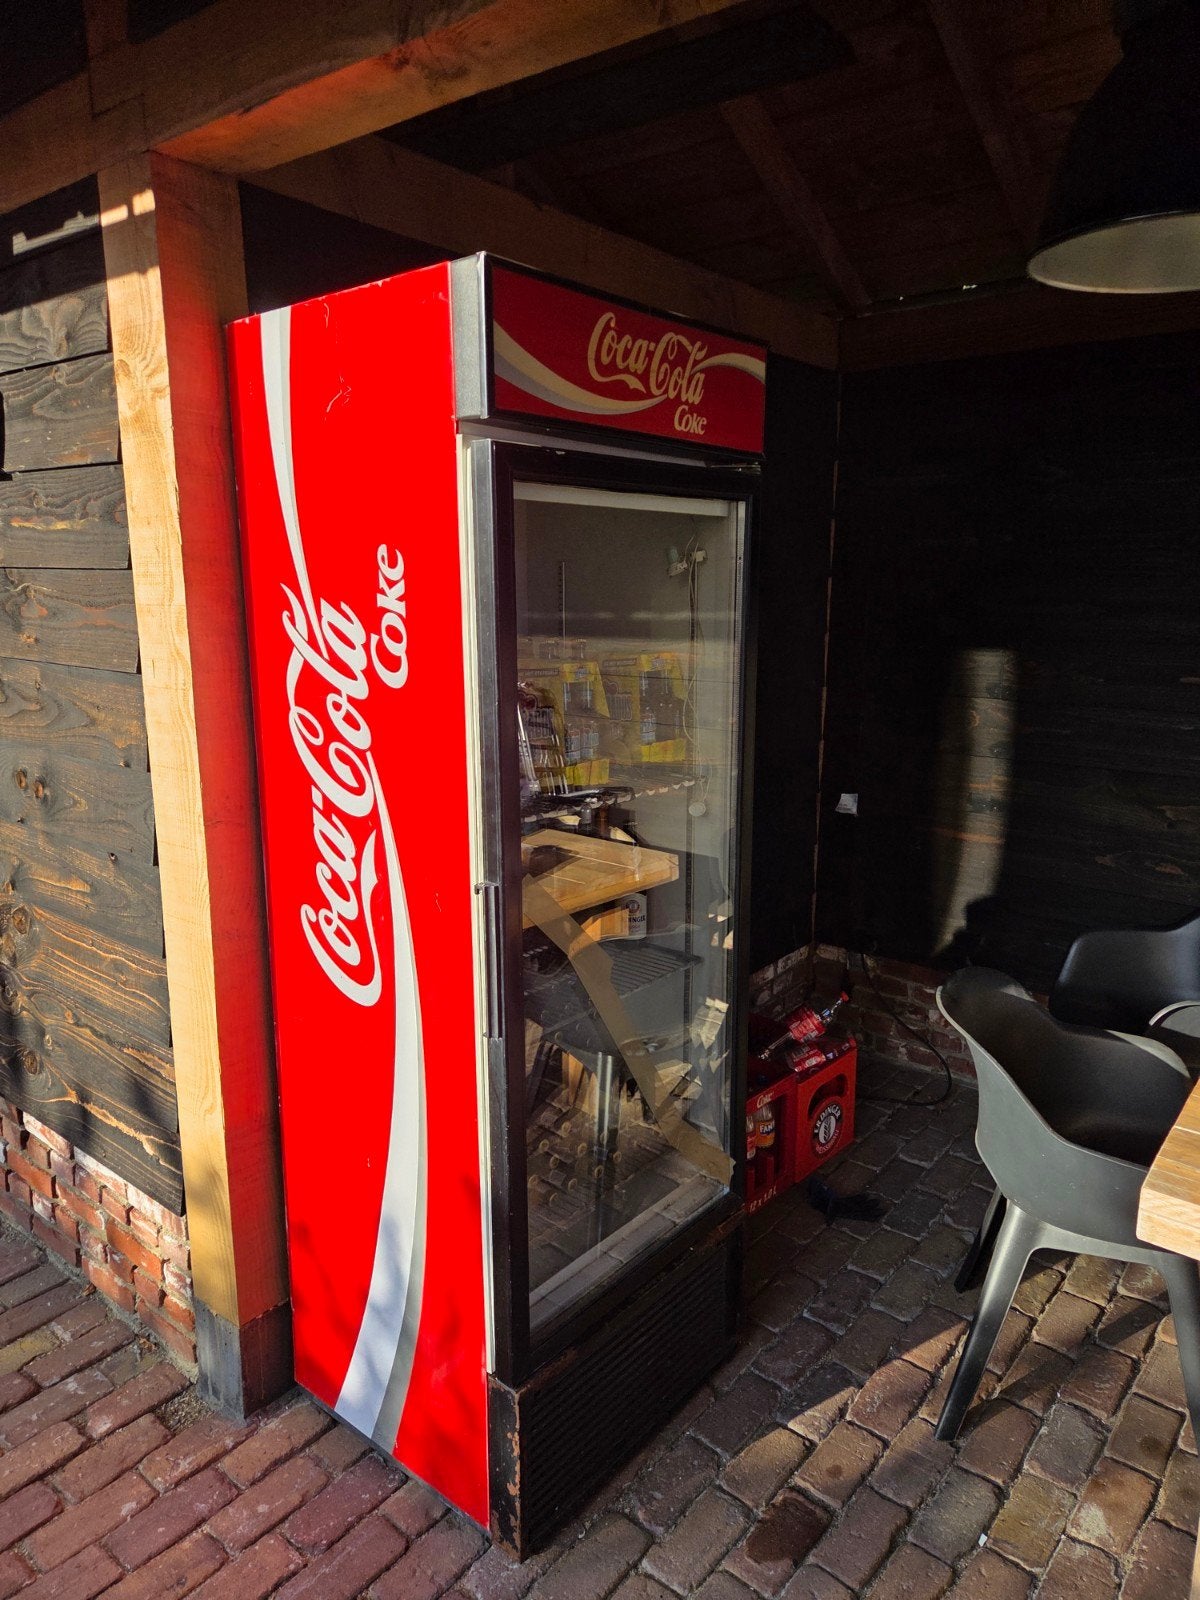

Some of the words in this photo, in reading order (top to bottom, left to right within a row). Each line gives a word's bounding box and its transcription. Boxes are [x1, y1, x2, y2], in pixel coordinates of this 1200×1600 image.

[587, 312, 708, 405] Coca-Cola
[673, 405, 707, 435] Coke
[371, 543, 408, 689] Coke
[280, 582, 382, 1007] Coca-Cola
